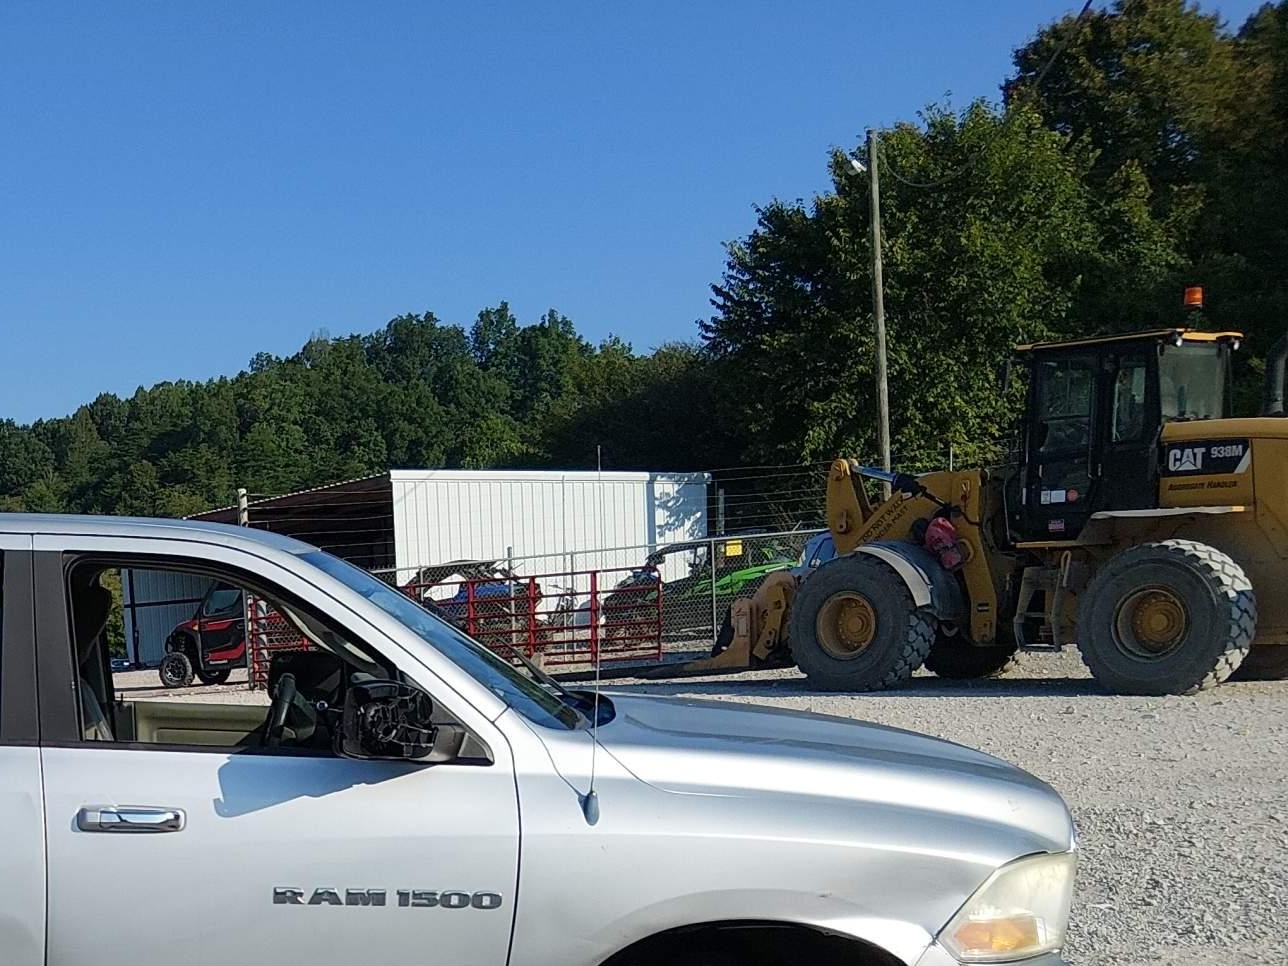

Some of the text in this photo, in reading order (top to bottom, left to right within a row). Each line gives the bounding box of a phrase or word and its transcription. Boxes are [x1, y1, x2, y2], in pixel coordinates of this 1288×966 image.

[1168, 444, 1243, 471] CAT 938M
[273, 887, 502, 910] RAM 1500
